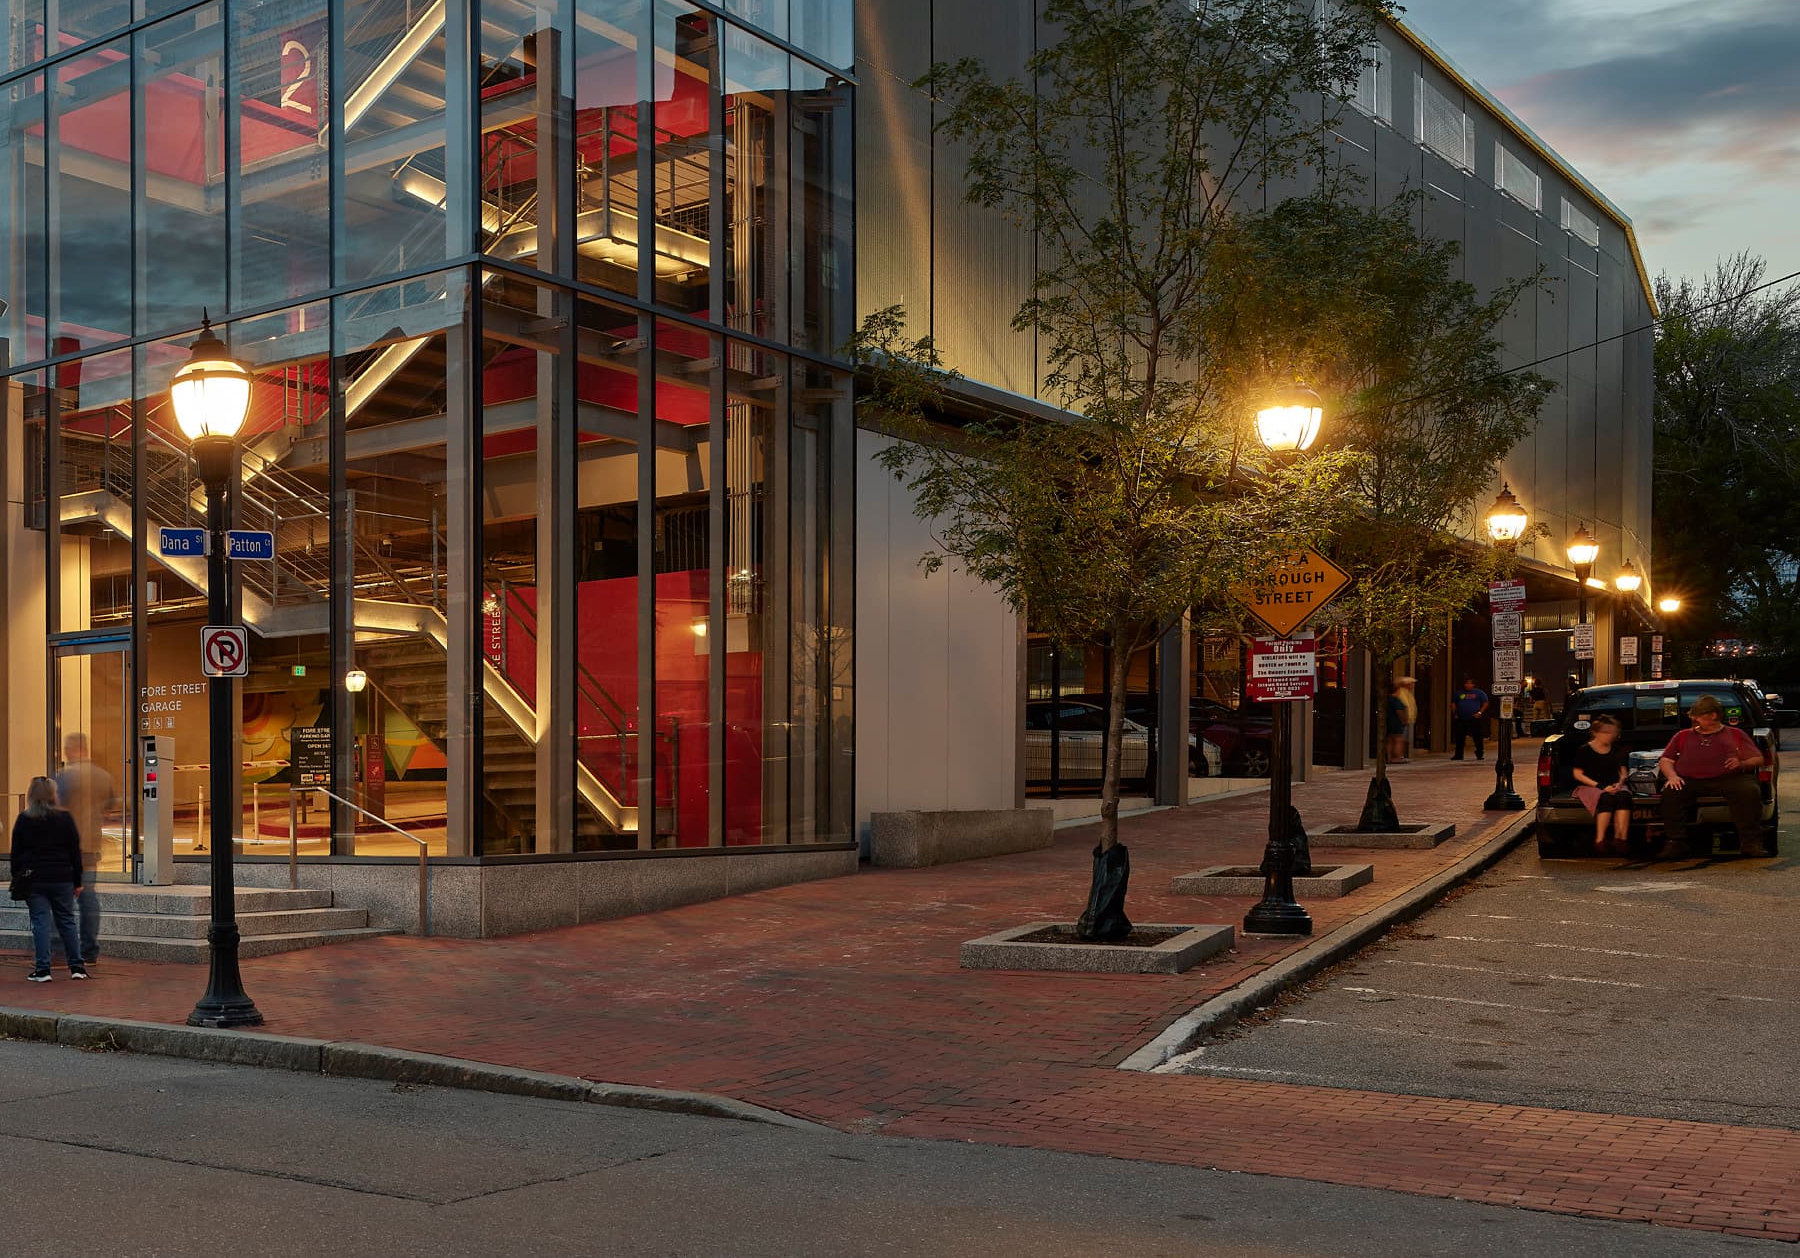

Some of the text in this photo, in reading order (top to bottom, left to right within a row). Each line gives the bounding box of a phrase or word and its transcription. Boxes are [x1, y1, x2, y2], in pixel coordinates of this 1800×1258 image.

[281, 40, 312, 113] 2
[161, 534, 203, 550] Dana St
[230, 537, 262, 552] Patton
[491, 603, 501, 650] STREE
[1273, 645, 1294, 653] Only
[141, 682, 207, 697] FORE STREET
[141, 700, 182, 713] GARAGE
